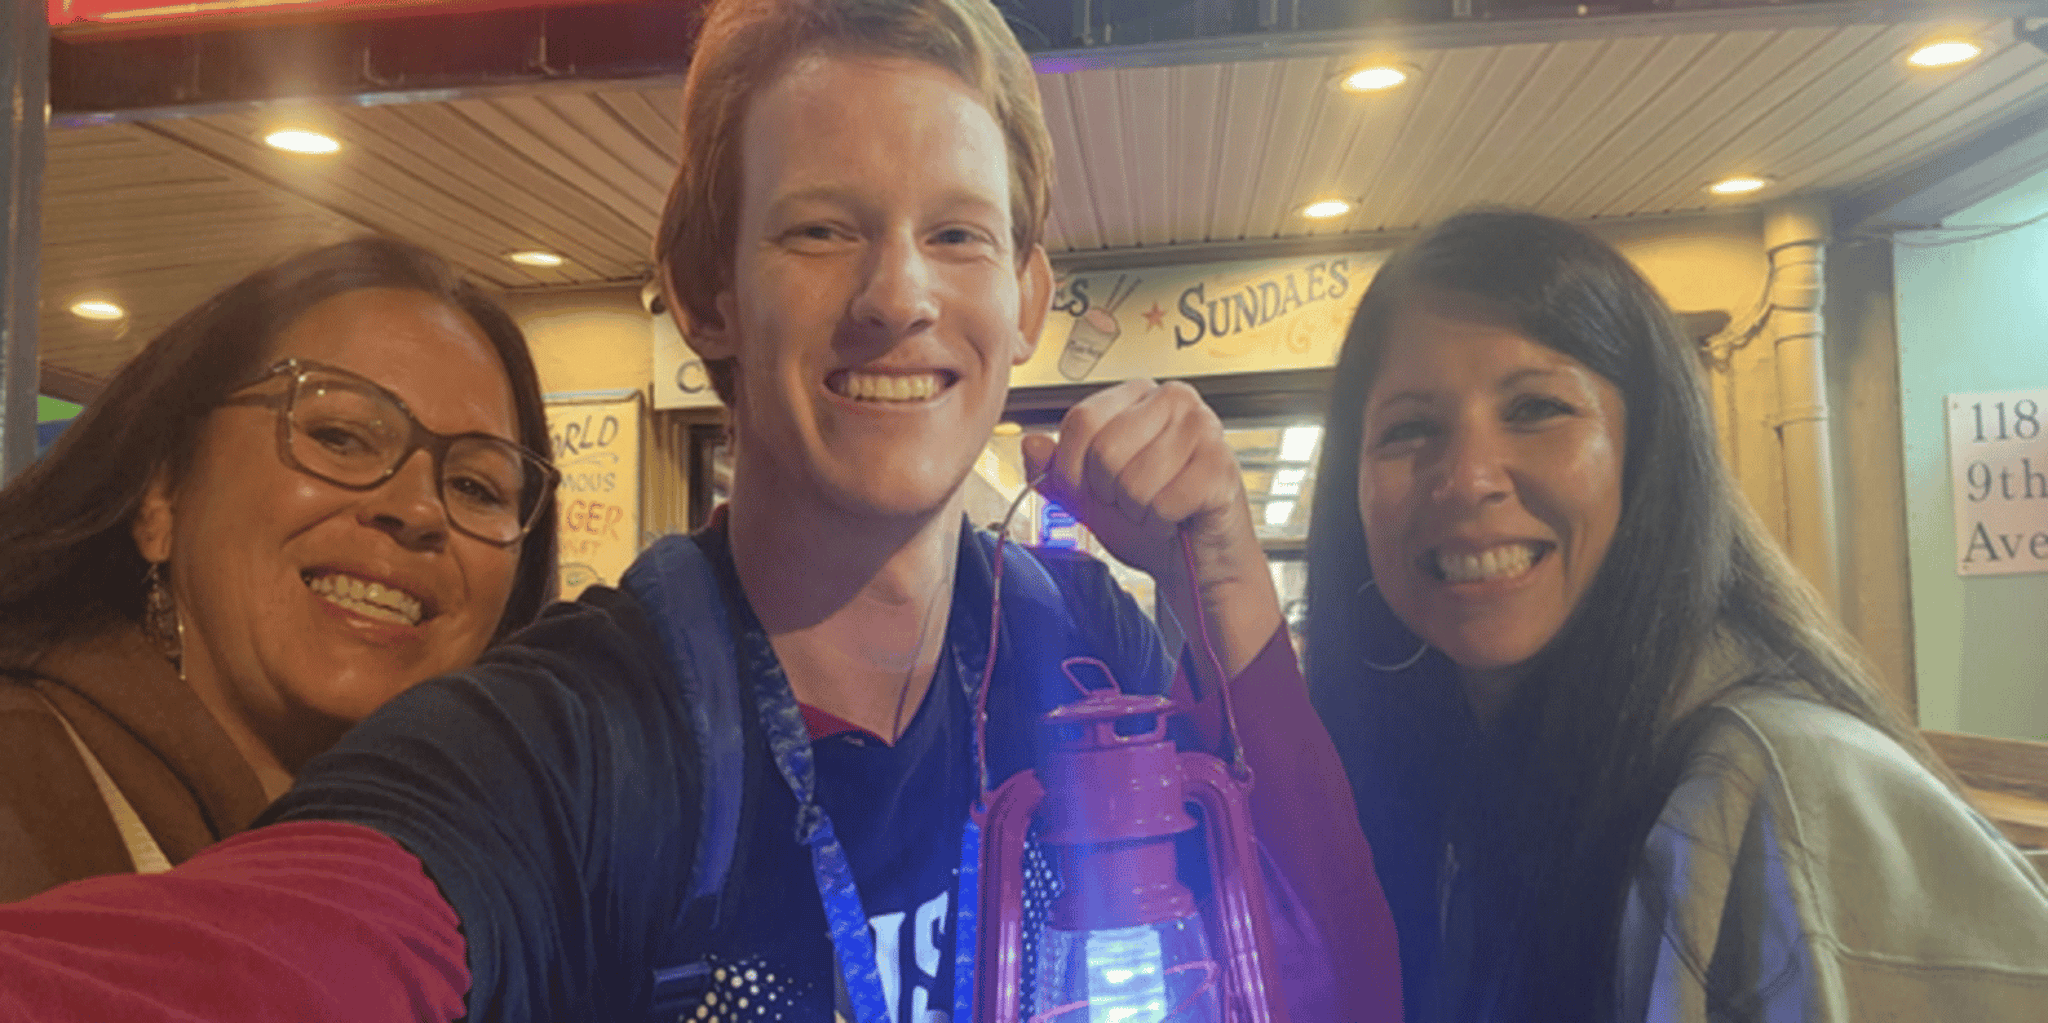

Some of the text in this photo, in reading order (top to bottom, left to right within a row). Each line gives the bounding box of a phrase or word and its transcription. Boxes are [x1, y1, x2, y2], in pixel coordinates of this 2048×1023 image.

[1174, 258, 1350, 350] SUNDAES
[1972, 399, 2041, 442] 118
[1967, 457, 2048, 502] 9th
[1963, 521, 2048, 563] Ave
